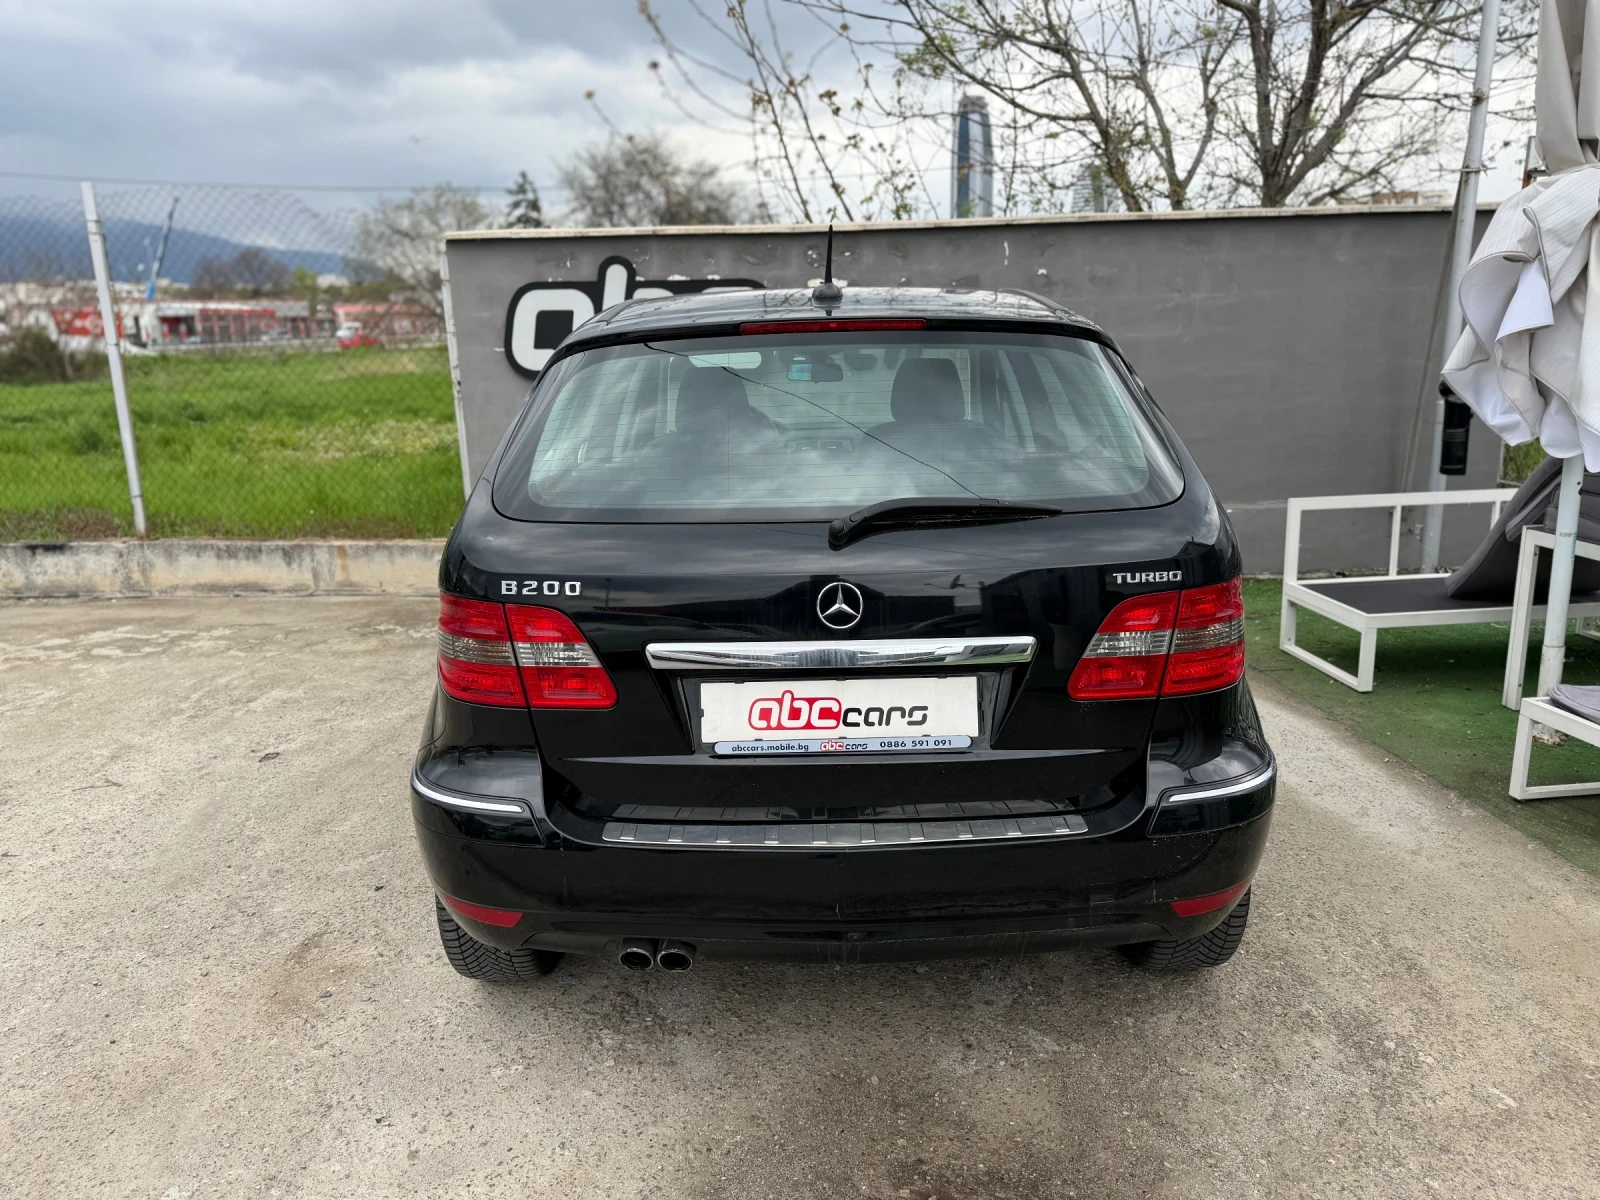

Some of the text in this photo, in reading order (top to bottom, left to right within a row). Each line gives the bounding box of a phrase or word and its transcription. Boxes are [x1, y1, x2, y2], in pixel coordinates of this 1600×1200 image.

[1112, 570, 1183, 584] TURBO
[501, 580, 582, 596] B200
[731, 743, 809, 753] abccars.mobile.bg
[880, 740, 907, 748] 0886
[911, 739, 930, 747] 591
[933, 739, 952, 747] 091
